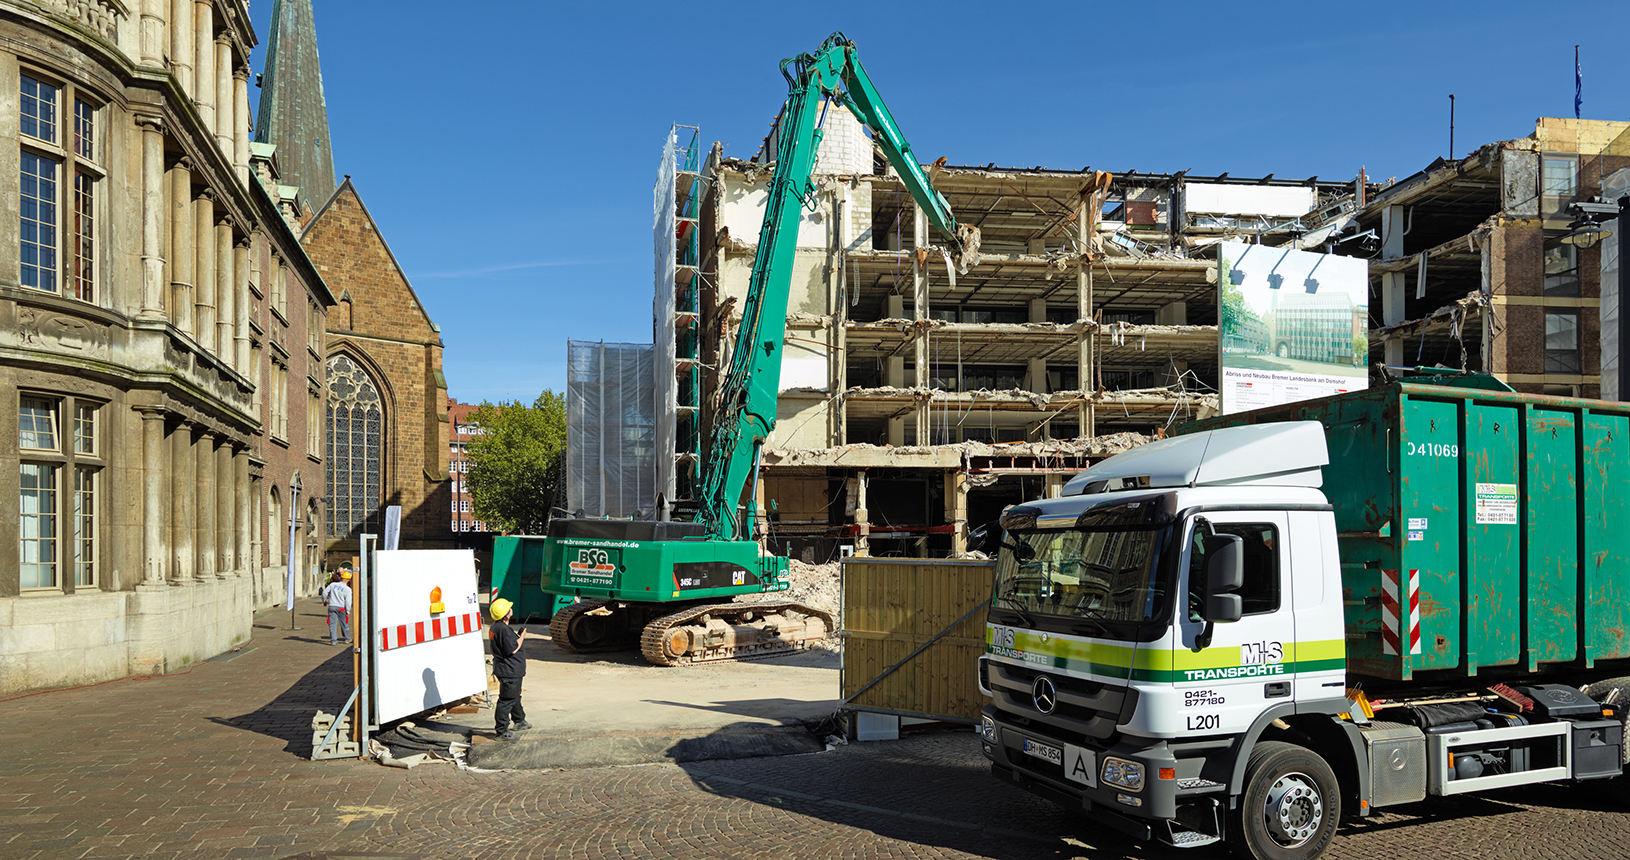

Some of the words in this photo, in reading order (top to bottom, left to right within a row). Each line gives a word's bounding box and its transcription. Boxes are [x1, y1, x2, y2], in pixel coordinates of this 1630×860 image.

[556, 539, 640, 548] www.bremer-sandhandel.de
[579, 549, 607, 569] BSG
[732, 571, 746, 585] CAT
[992, 645, 1048, 665] TRANSPORTE
[1184, 664, 1284, 681] TRANSPORTE
[1184, 689, 1218, 699] 0421-
[1184, 696, 1226, 707] 877180
[1187, 714, 1220, 731] L201
[1048, 748, 1060, 760] 854
[1072, 750, 1089, 781] A
[1314, 789, 1336, 853] CONTINENTAL
